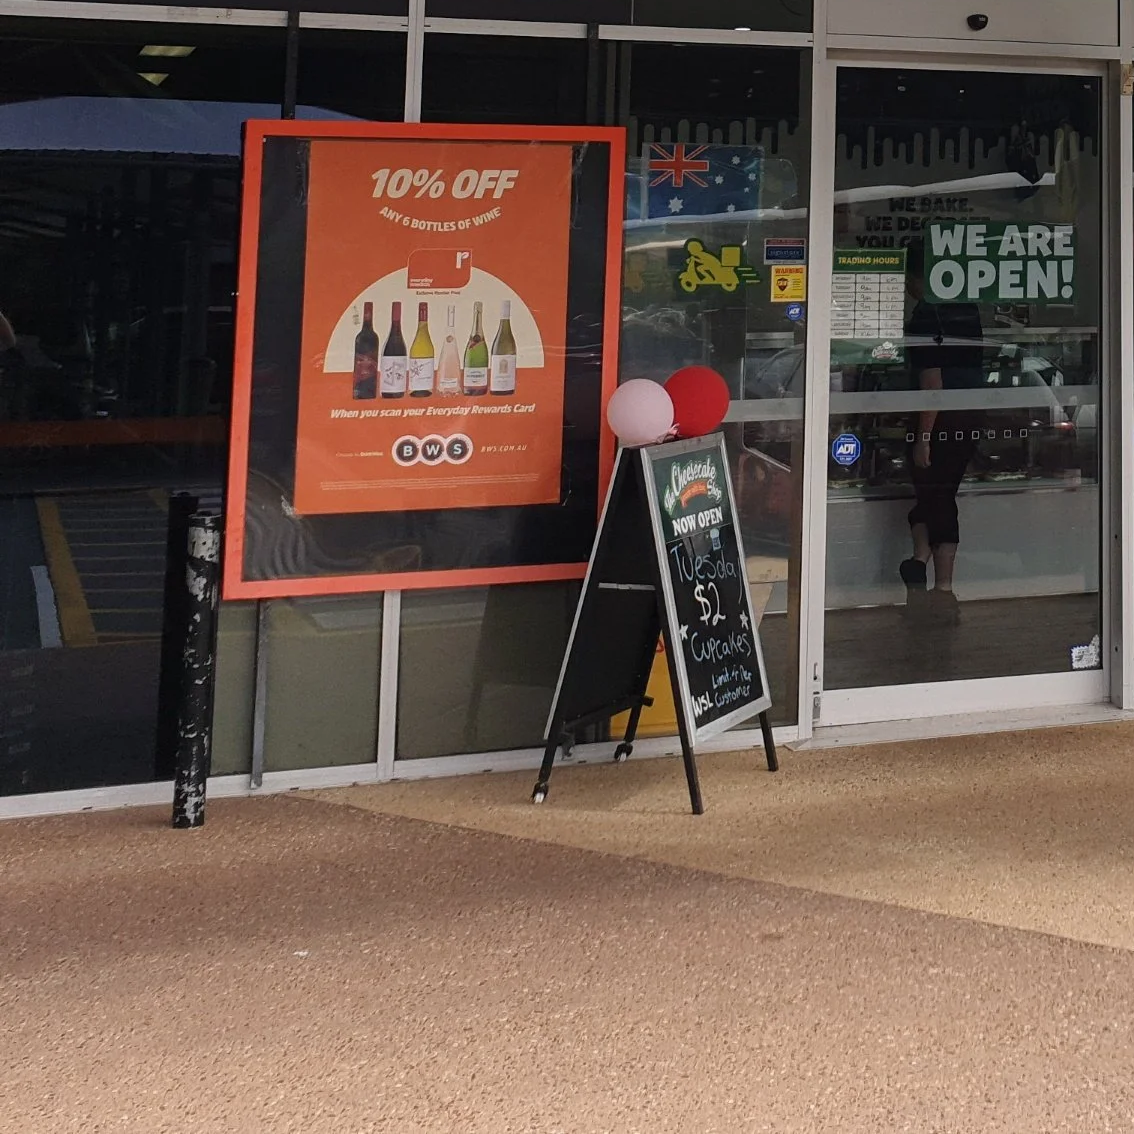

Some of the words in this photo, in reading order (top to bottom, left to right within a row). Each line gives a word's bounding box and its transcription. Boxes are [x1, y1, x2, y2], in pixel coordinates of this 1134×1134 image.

[370, 168, 447, 200] 10%
[451, 169, 520, 200] OFF
[379, 206, 403, 224] ANY
[403, 216, 411, 227] 6
[410, 218, 457, 233] BOTTLES
[457, 218, 472, 231] OF
[930, 224, 988, 257] WE
[998, 225, 1074, 257] ARE
[838, 256, 871, 265] TRADING
[873, 256, 900, 265] HOURS
[929, 260, 1074, 300] OPEN!
[331, 409, 358, 419] When
[360, 409, 378, 419] you
[379, 408, 402, 418] scan
[403, 407, 426, 417] your
[426, 406, 470, 417] Everyday
[471, 404, 511, 415] Rewards
[513, 403, 536, 414] Card
[837, 443, 856, 455] ADT
[671, 457, 717, 497] Cheesecake
[707, 478, 722, 502] Shop
[672, 514, 698, 536] NOW
[698, 506, 724, 529] OPEN
[670, 542, 743, 605] Tuesday
[693, 580, 726, 627] $2
[691, 632, 751, 664] Cupcakes
[715, 684, 751, 708] Customer
